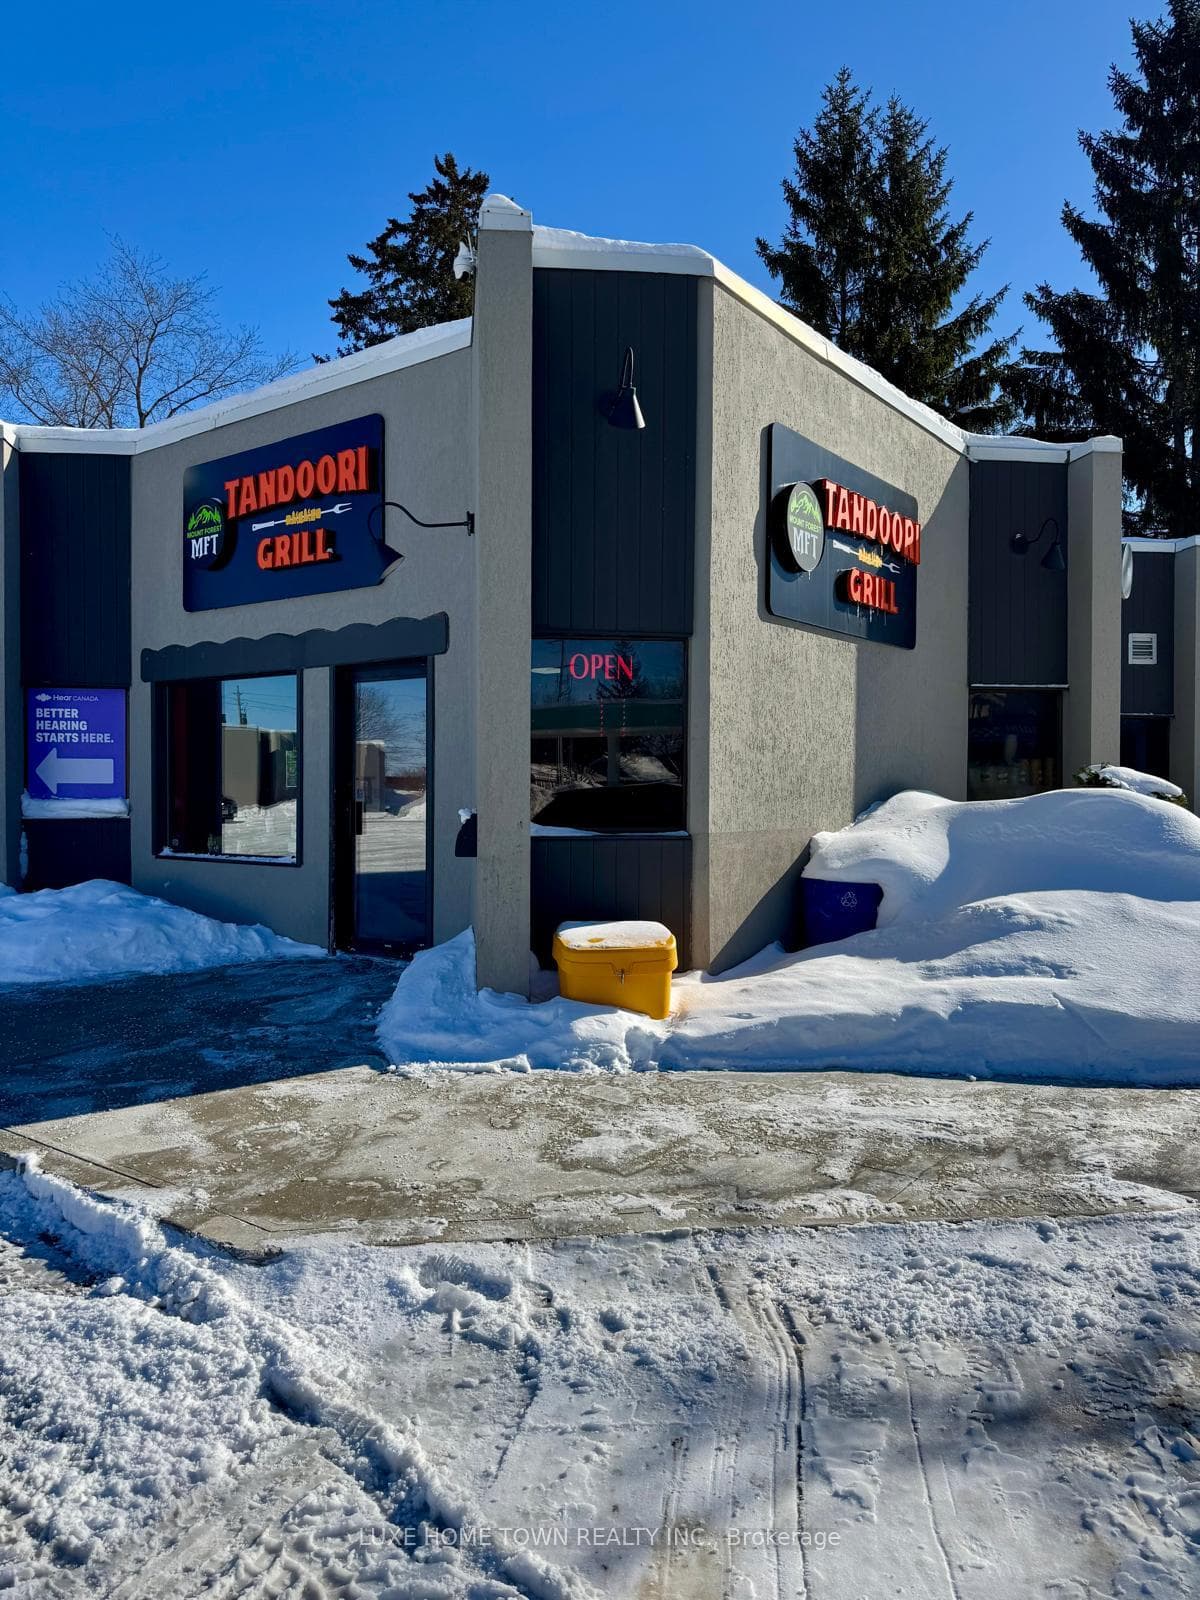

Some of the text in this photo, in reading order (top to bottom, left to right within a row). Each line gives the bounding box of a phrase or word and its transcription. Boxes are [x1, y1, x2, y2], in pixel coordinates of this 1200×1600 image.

[224, 445, 369, 519] TANDOORI
[205, 525, 222, 535] FOREST
[824, 479, 920, 565] TANDOORI
[191, 533, 219, 560] MFT
[256, 528, 330, 570] GRILL
[793, 526, 818, 560] MFT
[849, 567, 898, 614] GRILL
[569, 653, 633, 680] OPEN
[36, 708, 79, 719] BETTER
[36, 720, 88, 731] HEARING
[35, 732, 114, 743] STARTS HERE.
